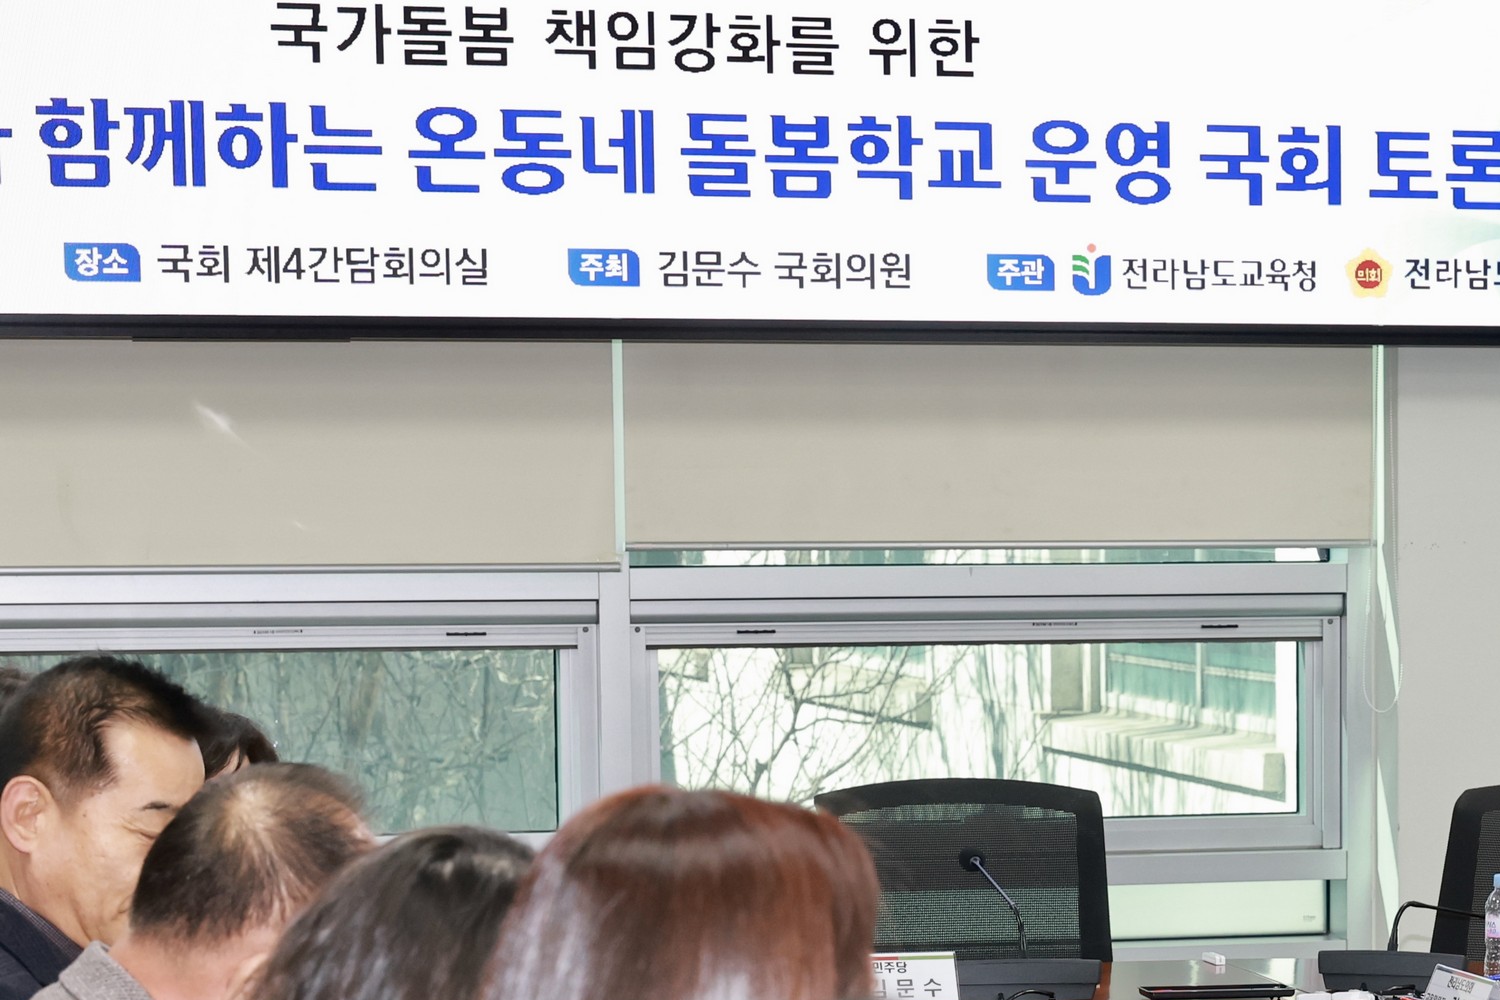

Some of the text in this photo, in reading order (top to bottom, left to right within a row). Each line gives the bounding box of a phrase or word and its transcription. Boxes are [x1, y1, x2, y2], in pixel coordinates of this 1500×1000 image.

[271, 2, 980, 78] 국가돌봄 책임강화를 위한
[35, 97, 383, 192] 함께하는
[408, 106, 656, 196] 온동네
[680, 112, 1002, 201] 돌봄학교
[1025, 119, 1172, 206] 운영
[1199, 124, 1342, 206] 국회
[74, 248, 130, 277] 장소
[157, 244, 488, 286] 국회 제4간담회의실
[579, 253, 628, 282] 주최
[658, 250, 911, 290] 김문수 국회의원
[997, 257, 1045, 283] 주관
[1122, 258, 1317, 292] 전라남도교육청
